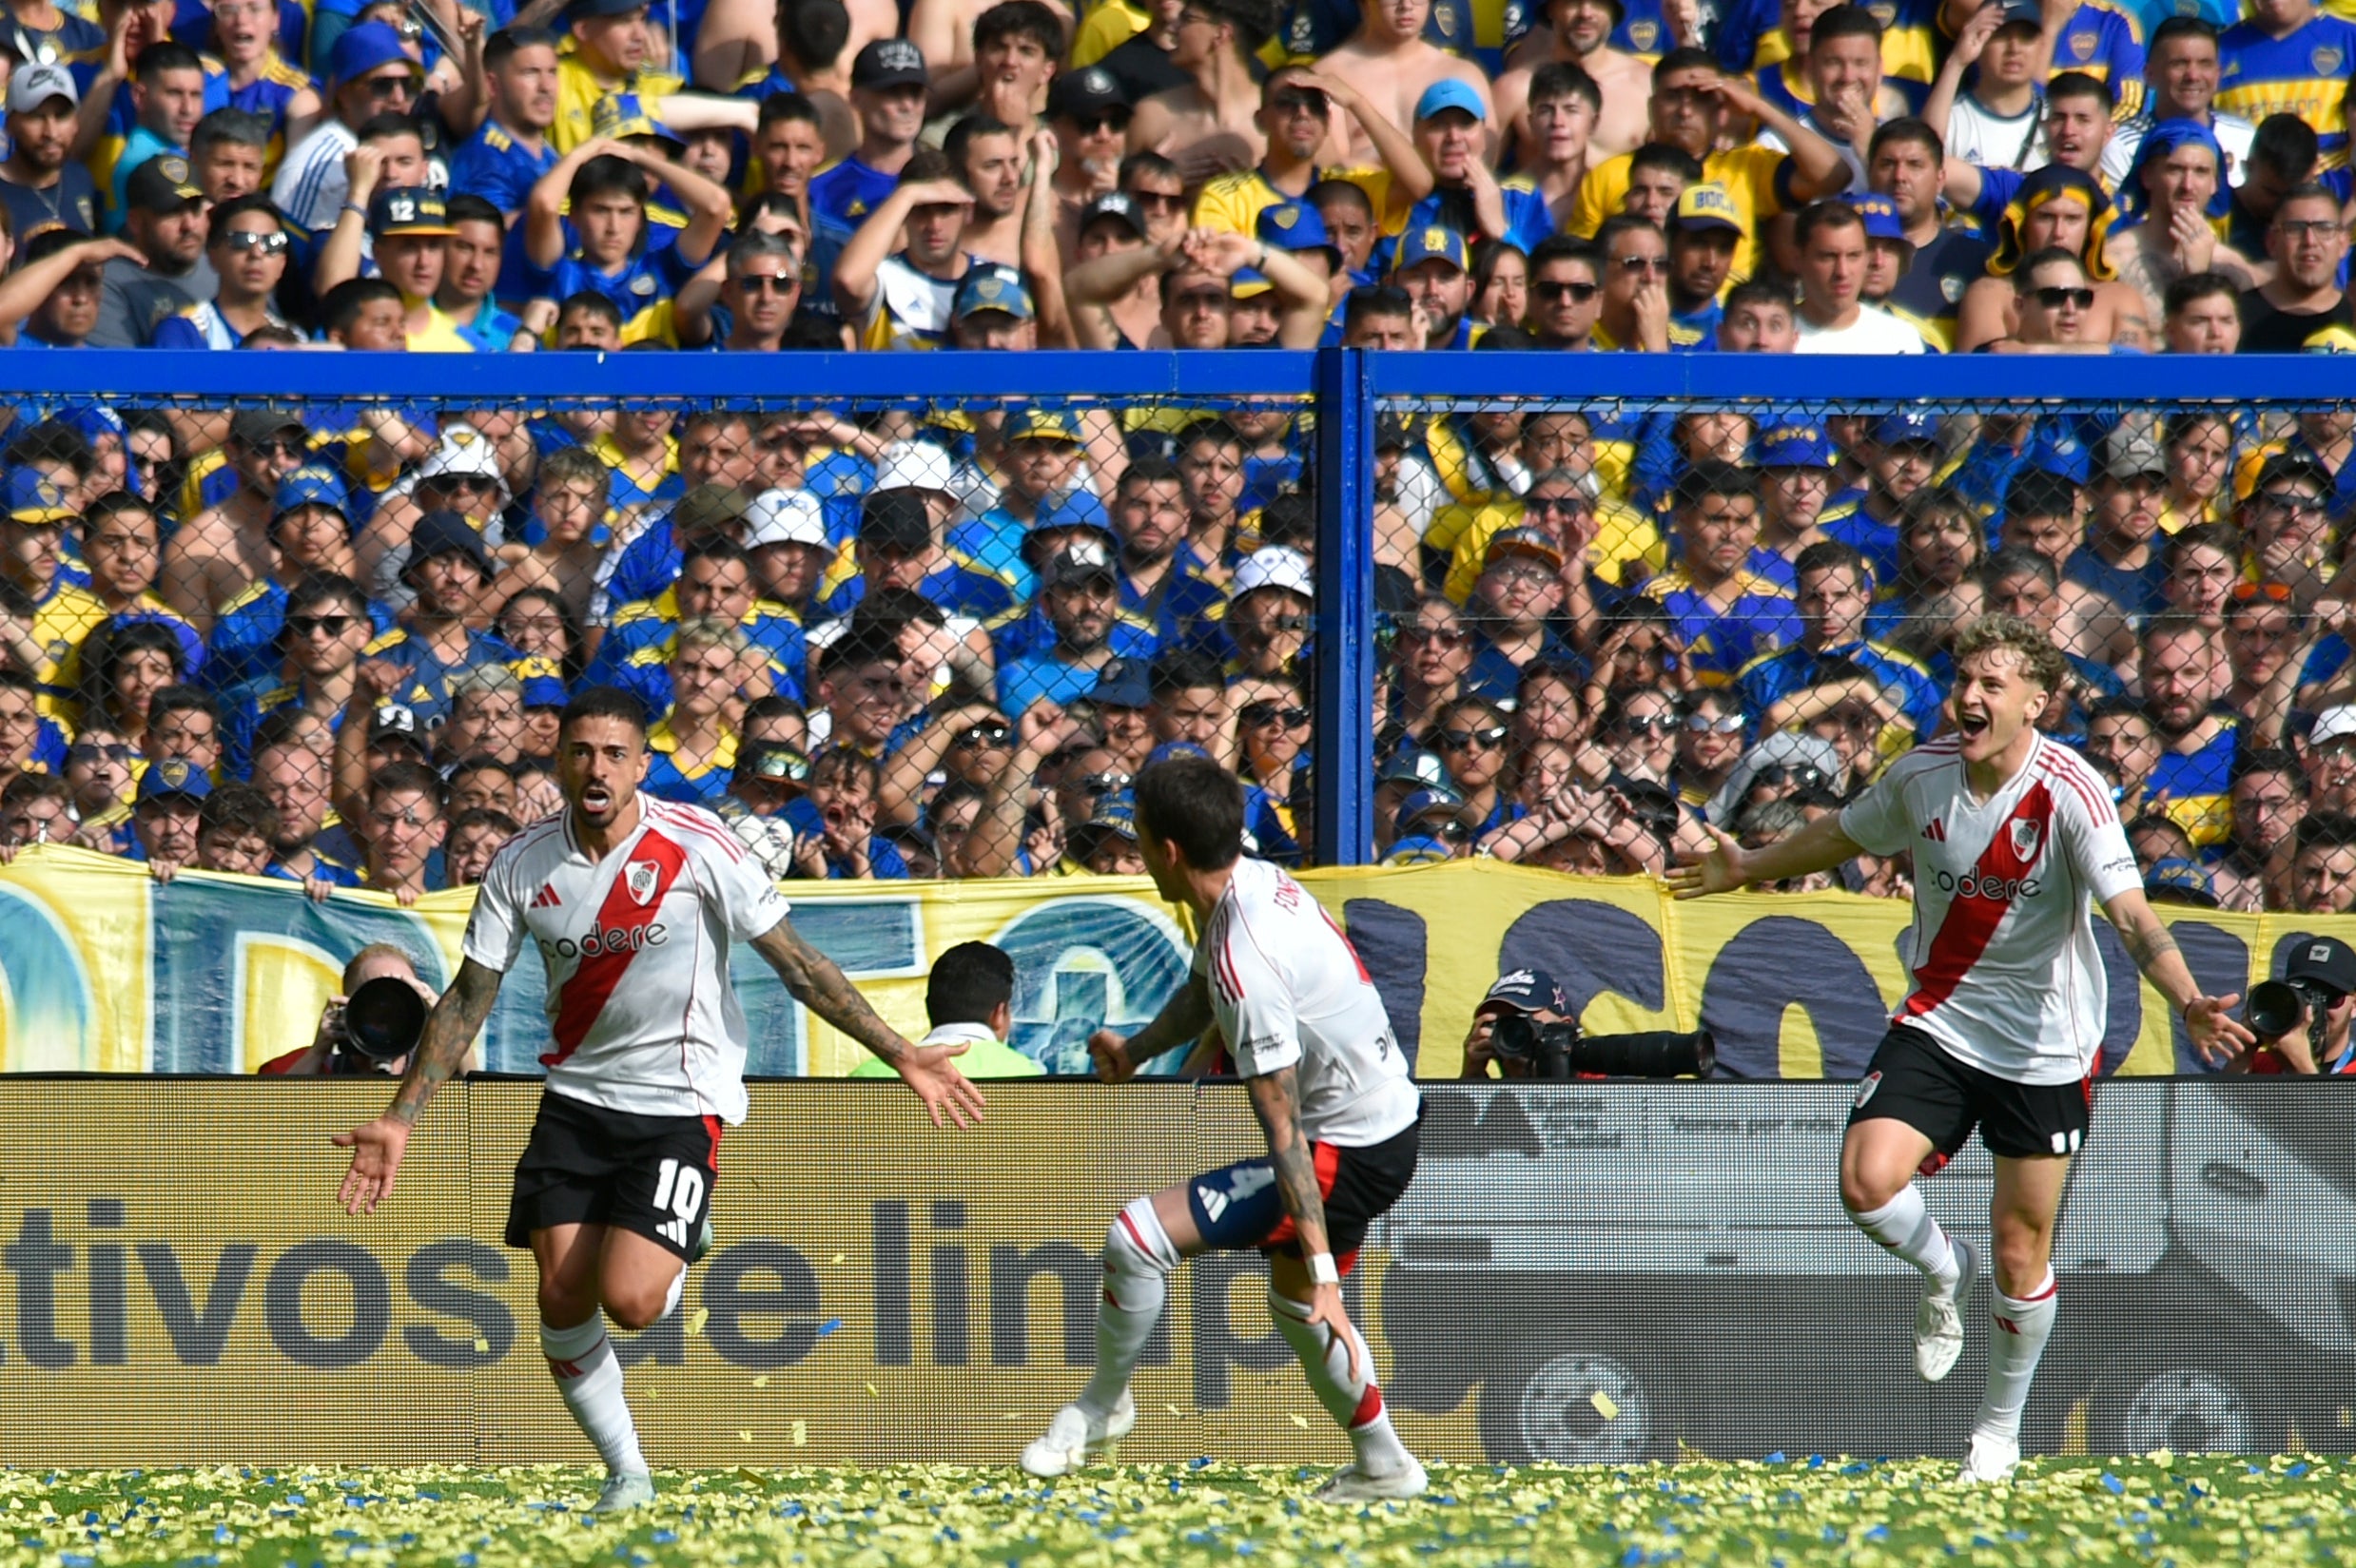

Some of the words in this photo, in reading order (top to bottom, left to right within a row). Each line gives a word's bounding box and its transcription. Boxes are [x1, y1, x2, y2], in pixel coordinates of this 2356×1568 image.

[390, 201, 415, 222] 12
[652, 1158, 704, 1225] 10
[0, 1199, 518, 1369] tivos
